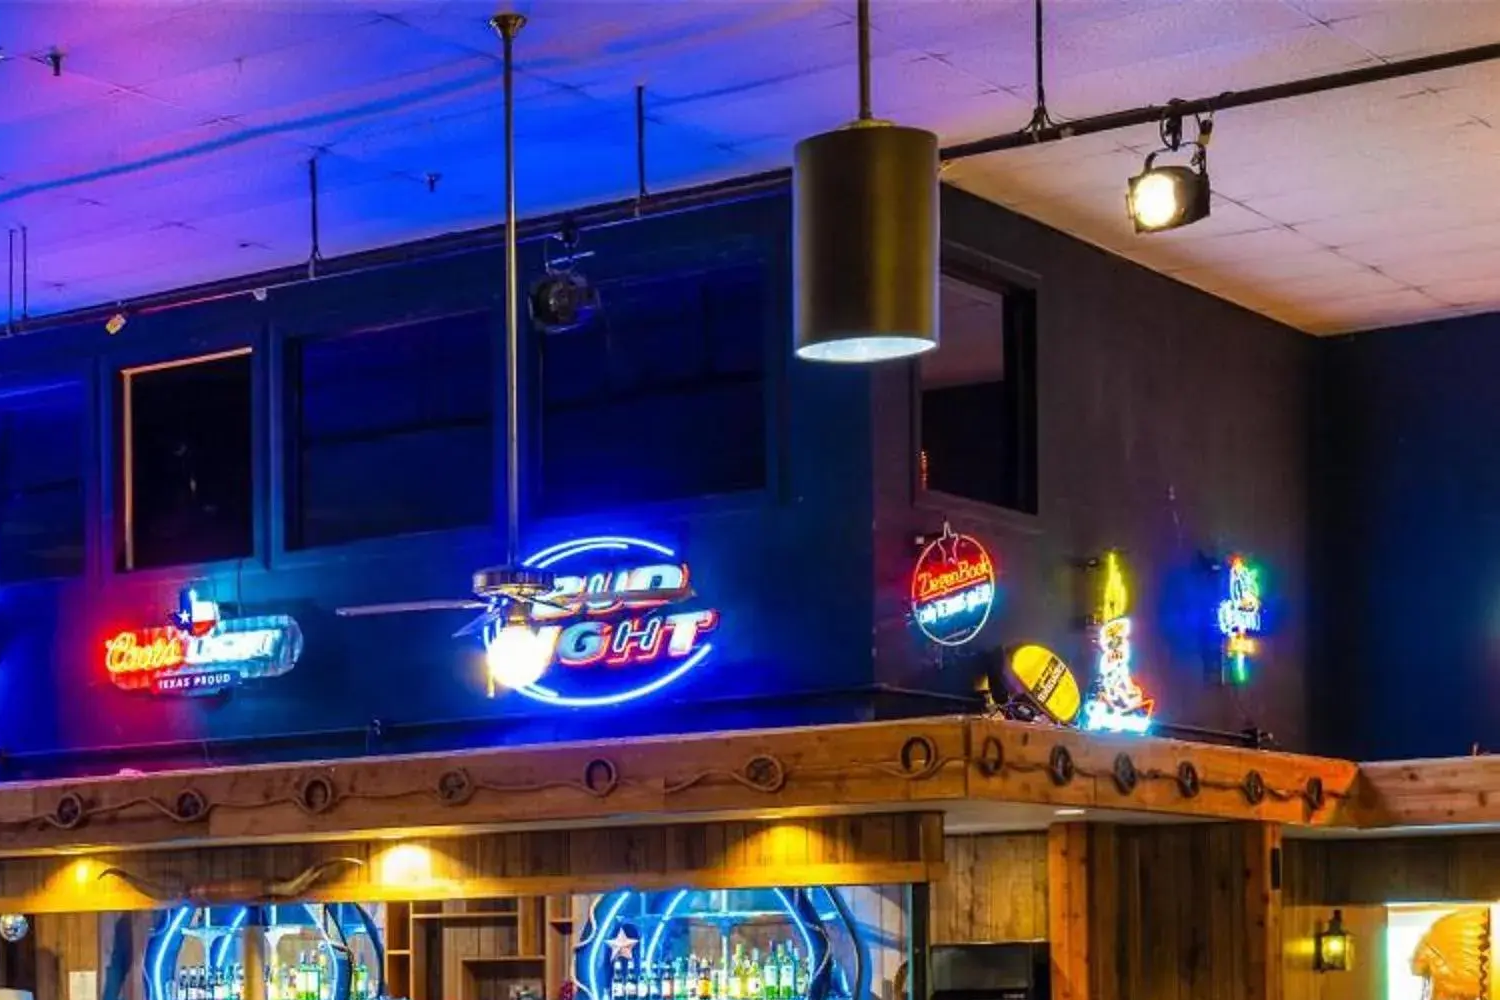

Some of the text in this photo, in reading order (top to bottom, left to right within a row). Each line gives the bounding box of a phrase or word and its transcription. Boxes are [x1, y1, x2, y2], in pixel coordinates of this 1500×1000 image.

[540, 608, 720, 668] GHT
[158, 673, 231, 690] TEXAS PROUD
